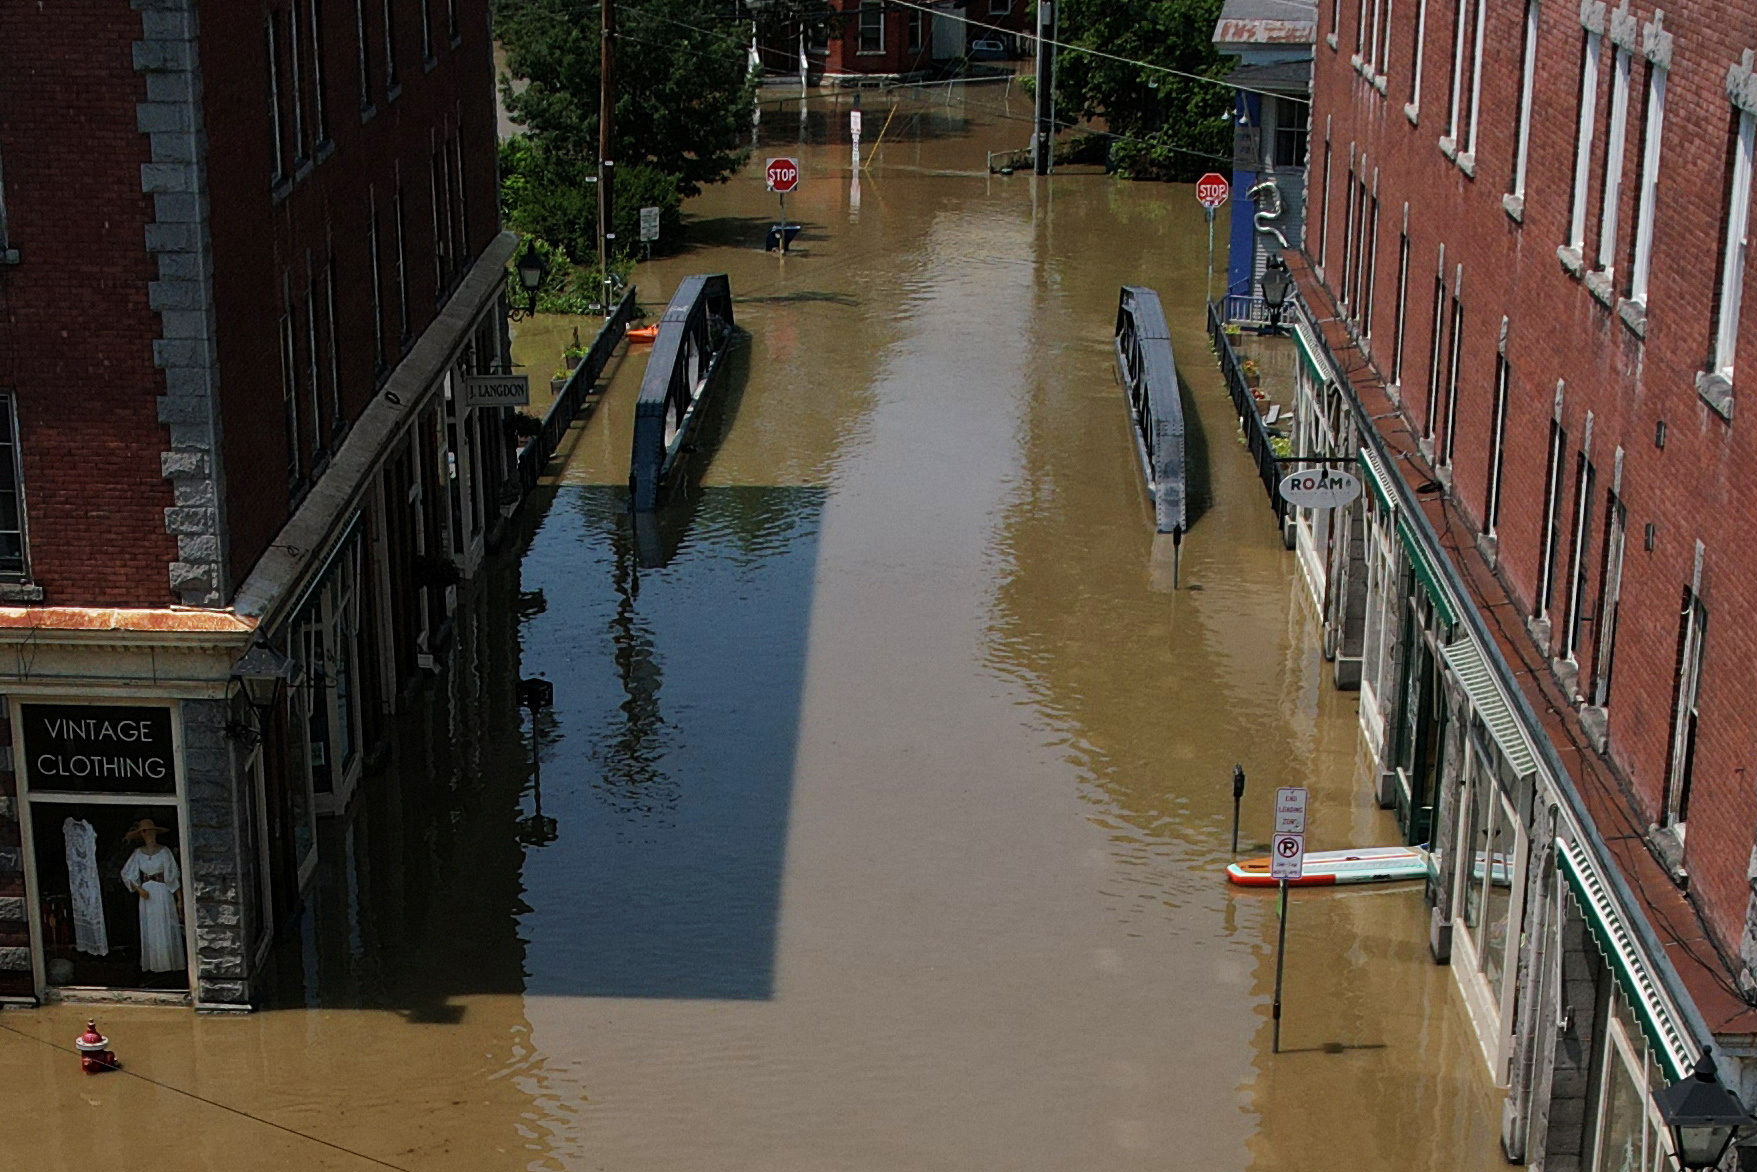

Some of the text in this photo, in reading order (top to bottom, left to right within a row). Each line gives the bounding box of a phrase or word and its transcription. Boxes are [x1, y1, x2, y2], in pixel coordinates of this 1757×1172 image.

[769, 169, 796, 181] STOP
[1199, 184, 1226, 197] STOP
[478, 383, 525, 397] LANGDON
[1291, 477, 1343, 491] ROAM
[44, 718, 153, 742] VINTAGE
[37, 754, 166, 779] CLOTHING
